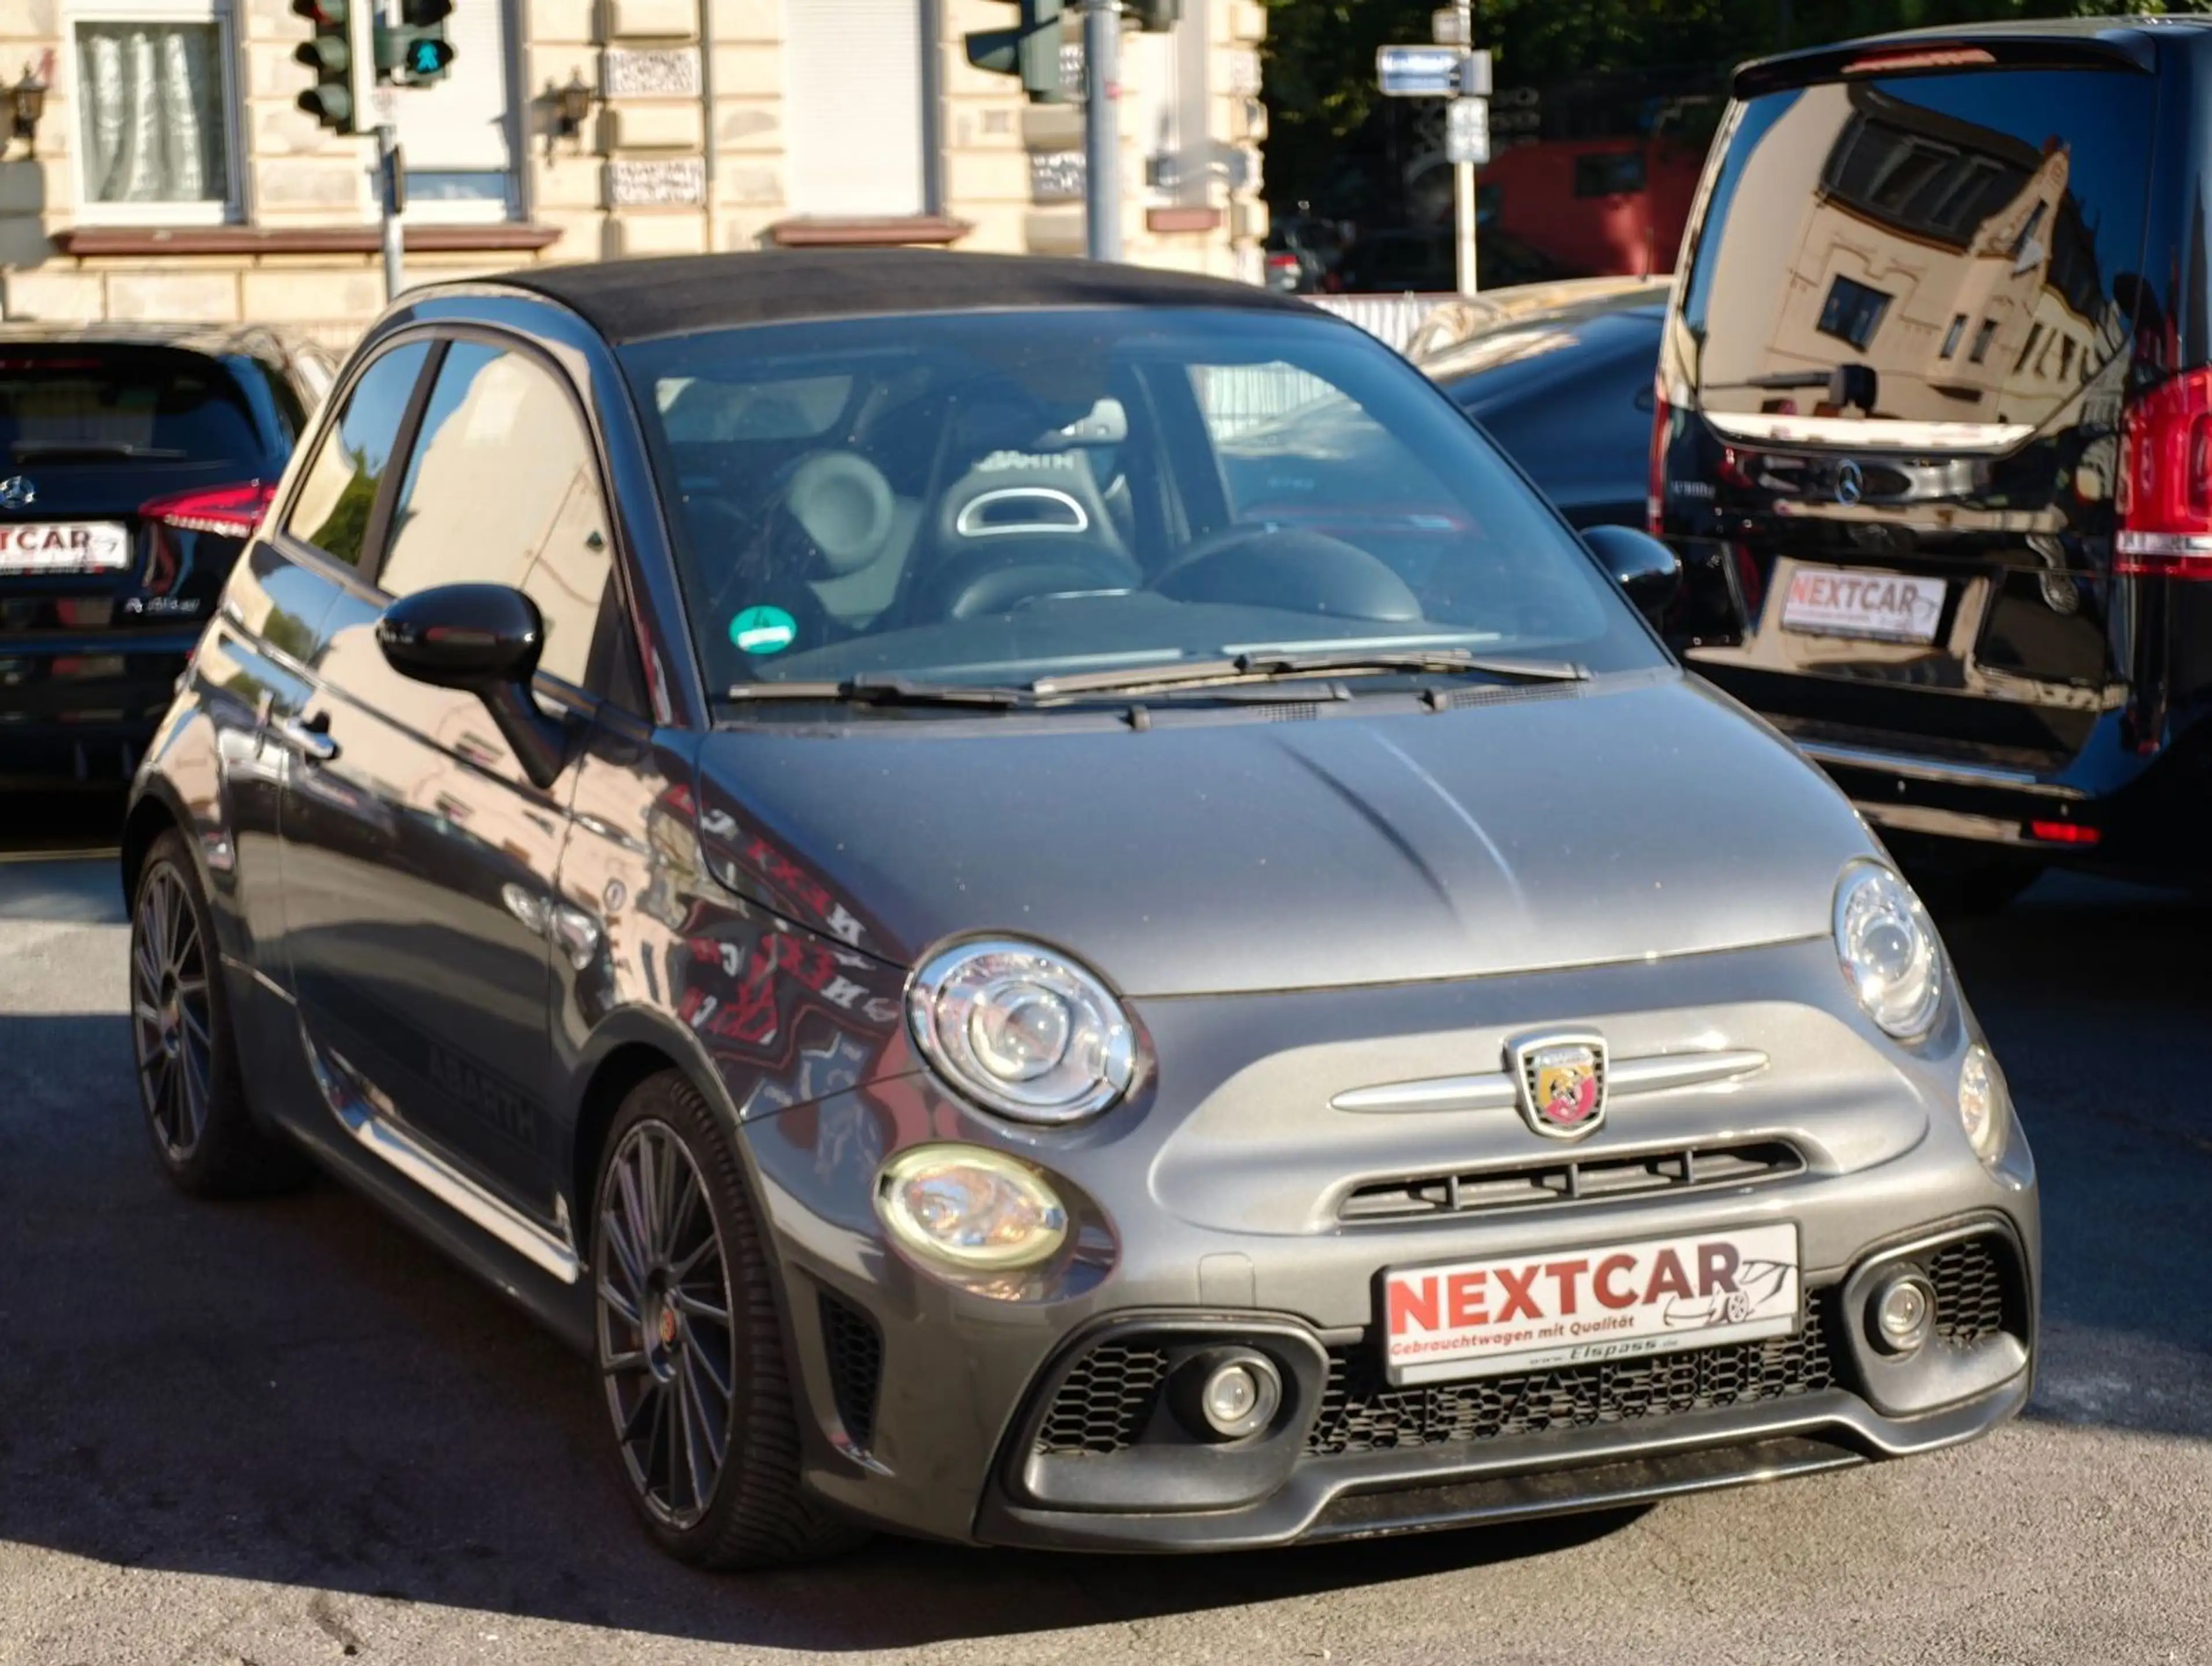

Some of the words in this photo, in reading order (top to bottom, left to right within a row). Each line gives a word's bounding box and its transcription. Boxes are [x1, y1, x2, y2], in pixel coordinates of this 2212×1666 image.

[1792, 578, 1919, 614] NEXTCAR
[1389, 1241, 1739, 1335] NEXTCAR
[1391, 1329, 1533, 1355] Gebrauchtwagen
[1539, 1322, 1564, 1339] mit
[1570, 1315, 1635, 1336] Qualität
